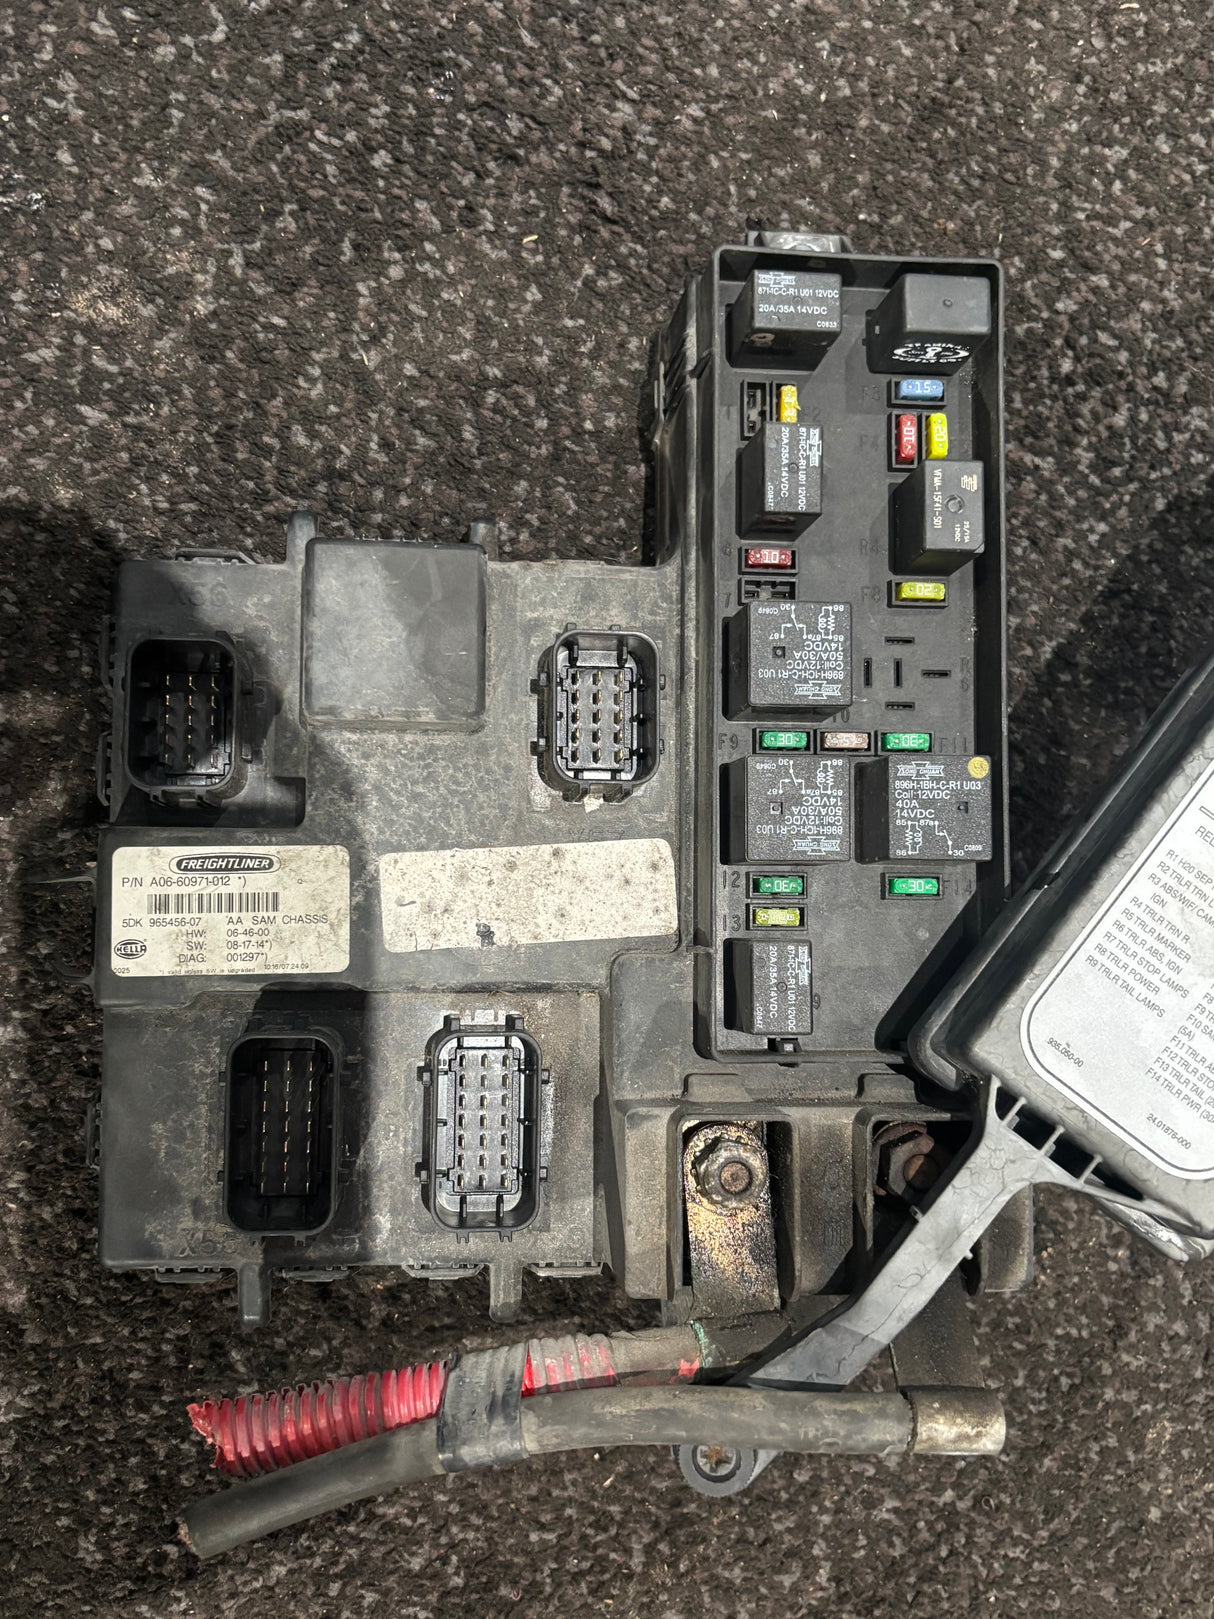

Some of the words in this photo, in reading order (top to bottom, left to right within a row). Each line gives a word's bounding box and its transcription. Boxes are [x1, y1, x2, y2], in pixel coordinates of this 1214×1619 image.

[815, 289, 839, 298] 12VDC
[759, 304, 795, 313] 20A/35A
[797, 306, 828, 315] 14VDC
[915, 381, 931, 393] 15
[903, 427, 915, 443] 10
[934, 425, 946, 442] 20
[781, 427, 789, 465] 20A/35A
[780, 466, 789, 498] 14VDC
[798, 487, 806, 511] 12VDC
[763, 551, 779, 564] 10
[916, 584, 932, 596] 20
[780, 603, 791, 611] 30
[804, 641, 843, 651] 14VDC
[792, 651, 844, 660] 50A/30A
[786, 660, 844, 670] Coil:12VDC
[758, 669, 775, 678] U03
[778, 669, 844, 680] 896H-1CH-C-R1
[777, 733, 793, 745] 30
[902, 735, 918, 747] 30
[778, 758, 789, 766] 30
[894, 780, 961, 790] 896H-1BH-C-R1
[963, 781, 981, 790] U03
[802, 796, 842, 806] 14VDC
[895, 799, 919, 808] 40A
[791, 806, 843, 816] 50A/30A
[895, 809, 935, 818] 14VDC
[784, 815, 843, 825] Coil:12VDC
[756, 825, 774, 834] U03
[776, 825, 843, 835] 896H-1CH-C-R1
[180, 858, 270, 870] FREIGHTLINER
[1165, 849, 1180, 862] R1
[1193, 869, 1214, 885] SEP
[122, 877, 143, 888] P/N
[150, 876, 231, 887] A06-60971-012
[1147, 872, 1162, 886] R3
[1156, 860, 1171, 875] R2
[1169, 868, 1193, 891] TRLR
[1190, 884, 1210, 903] TRN
[774, 880, 791, 892] 30
[908, 880, 924, 892] 30
[1149, 892, 1168, 909] IGN
[122, 918, 143, 928] 5DK
[149, 917, 202, 928] 965456-07
[251, 915, 277, 926] SAM
[282, 914, 329, 925] CHASSIS
[1129, 895, 1144, 909] R4
[1142, 903, 1166, 926] TRLR
[1164, 920, 1184, 939] TRN
[1180, 933, 1191, 945] R
[186, 929, 207, 939] HW:
[226, 928, 270, 938] 06-46-00
[1120, 907, 1135, 921] R5
[1133, 915, 1157, 938] TRLR
[1153, 932, 1192, 964] MARKER
[186, 941, 207, 951] SW:
[1111, 919, 1126, 933] R6
[1124, 927, 1148, 950] TRLR
[1144, 945, 1166, 965] ABS,
[1165, 958, 1184, 976] IGN
[178, 953, 207, 964] DIAG:
[769, 945, 778, 985] 20A/35A
[1102, 930, 1118, 944] R7
[1115, 938, 1139, 961] TRLR
[1136, 956, 1162, 976] STOP
[1159, 972, 1190, 999] LAMPS
[1093, 942, 1108, 956] R8
[1106, 950, 1130, 973] TRLR
[1127, 967, 1161, 996] POWER
[1084, 954, 1099, 968] R9
[1097, 962, 1121, 985] TRLR
[1119, 978, 1136, 998] TAIL
[1135, 992, 1166, 1018] LAMPS
[769, 987, 778, 1019] 14VDC
[1201, 992, 1214, 1005] F8
[1193, 1002, 1207, 1016] F9
[787, 1007, 796, 1032] 12VDC
[1185, 1013, 1203, 1030] F10
[1177, 1024, 1196, 1042] (5A)
[1169, 1034, 1186, 1051] F11
[1184, 1044, 1208, 1067] TRLR
[1160, 1045, 1179, 1062] F12
[1176, 1055, 1199, 1078] TRLR
[1153, 1056, 1171, 1072] F13
[1168, 1066, 1191, 1088] TRLR
[1189, 1082, 1206, 1101] TAIL
[1144, 1067, 1163, 1083] F14
[1160, 1077, 1183, 1099] TRLR
[1180, 1093, 1202, 1113] PWR
[1146, 1112, 1192, 1150] 24.01876-000
